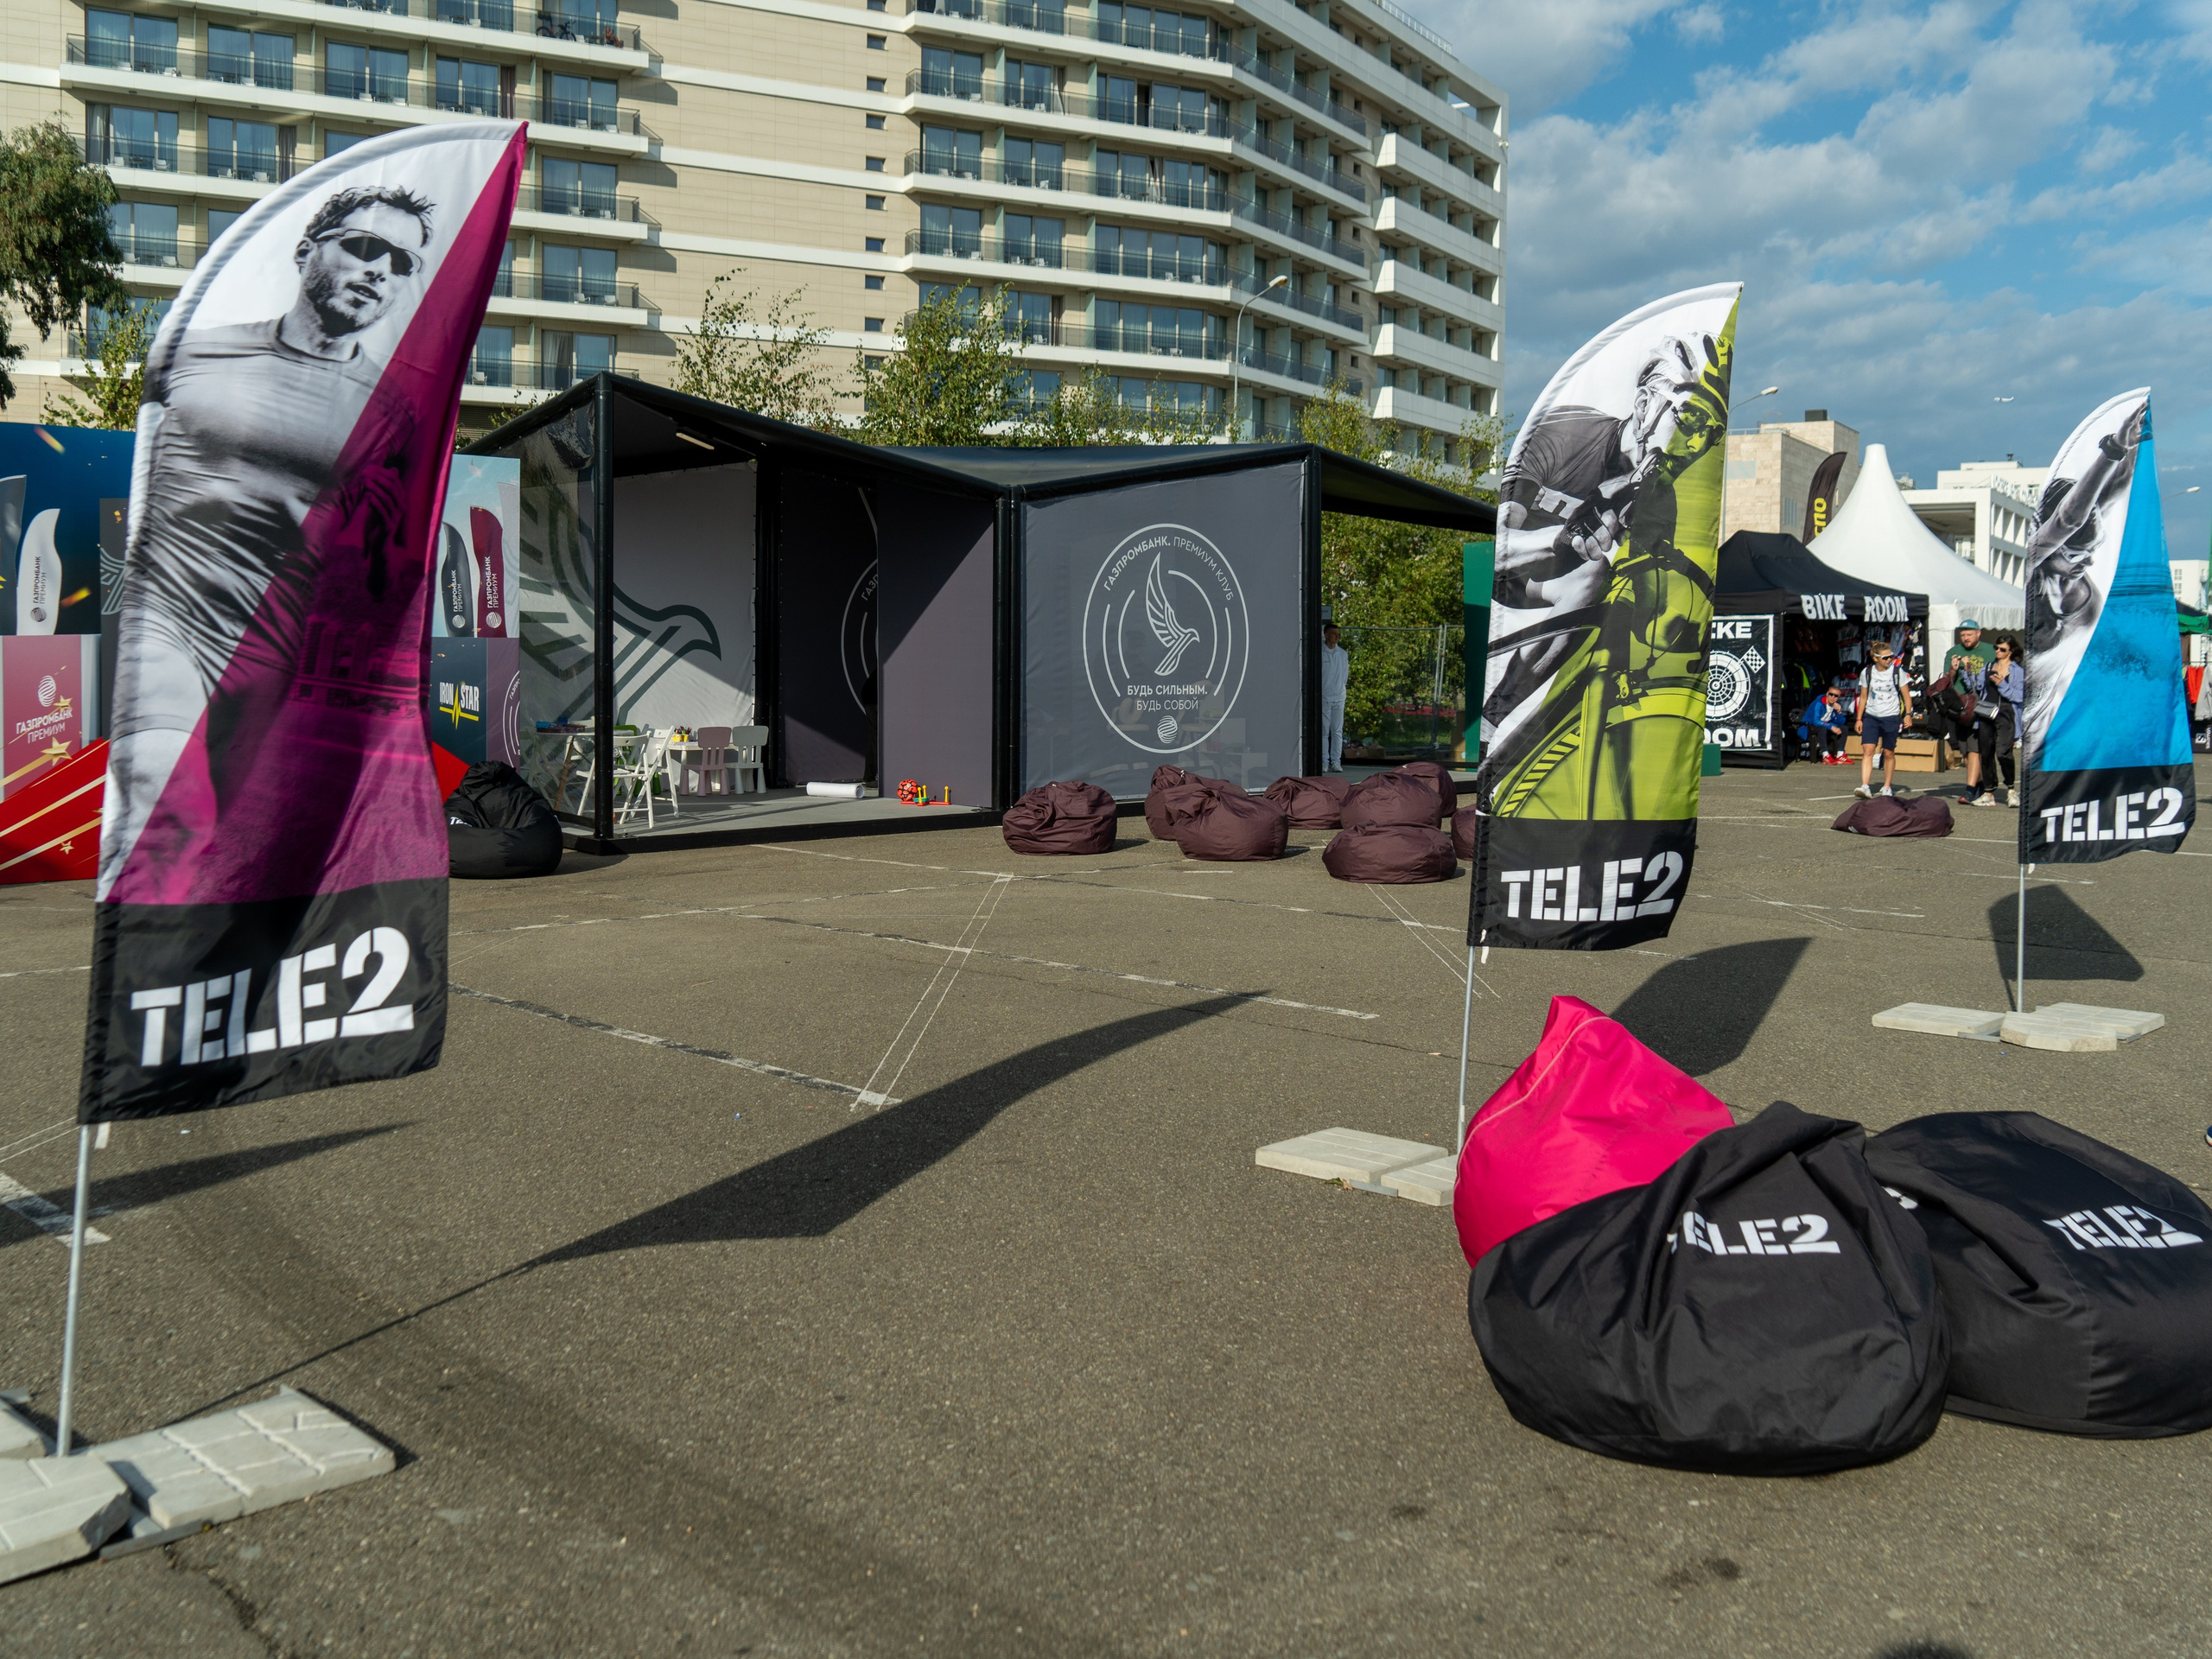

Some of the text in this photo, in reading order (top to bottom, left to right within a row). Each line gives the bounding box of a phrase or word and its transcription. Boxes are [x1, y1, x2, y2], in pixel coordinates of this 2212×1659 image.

[33, 556, 41, 604] ГАЗПРОМБАНК
[450, 569, 459, 613] ГАЗПРОМБАНК
[484, 556, 493, 608] ГАЗПРОМБАНК
[1103, 536, 1234, 601] ГАЗПРОМБАНК. ПРЕМИУМ КЛУБ
[1800, 594, 1910, 622] BIKE ROOM
[439, 682, 480, 712] IRON STAR
[1127, 684, 1208, 696] БУДЬ СИЛЬНЫМ.
[1136, 696, 1198, 712] БУДЬ СОБОЙ
[16, 709, 73, 734] ГАЗПРОМБАНК
[27, 722, 66, 744] ПРЕМИУМ
[2039, 786, 2186, 842] TELE2
[1500, 850, 1683, 922] TELE2
[130, 925, 415, 1067] TELE2
[2041, 1205, 2204, 1251] TELE2
